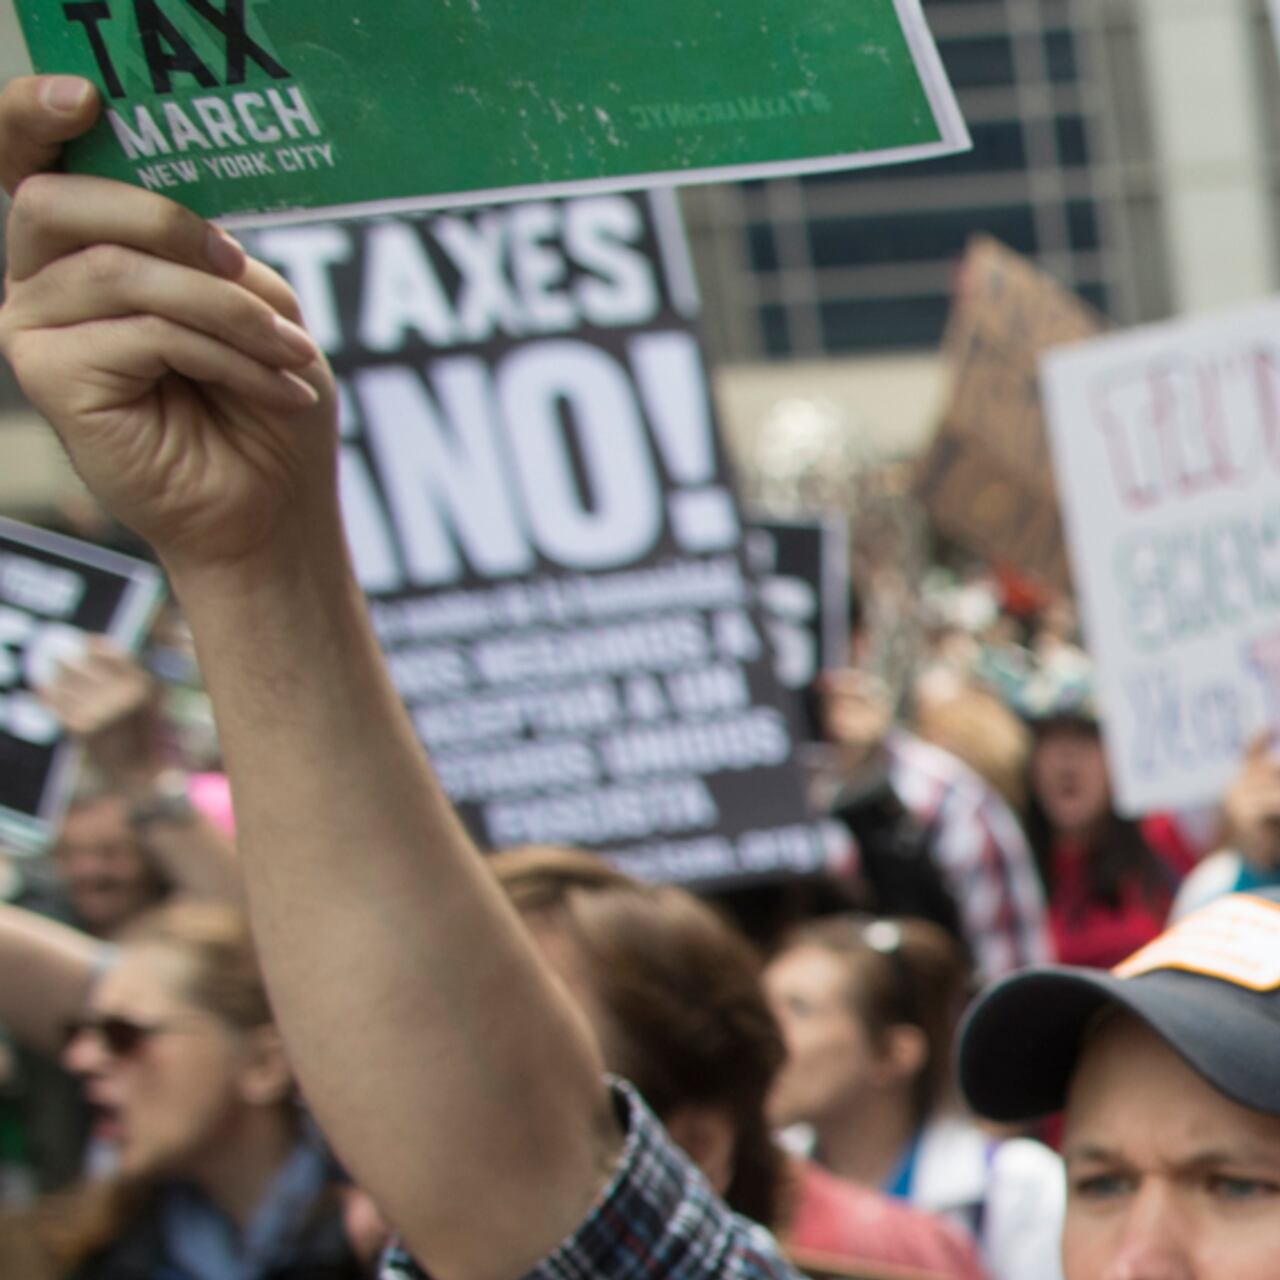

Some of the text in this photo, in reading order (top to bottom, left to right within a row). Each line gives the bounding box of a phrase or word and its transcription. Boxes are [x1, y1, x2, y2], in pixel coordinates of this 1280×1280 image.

[63, 0, 293, 98] TAX
[105, 86, 321, 160] MARCH
[136, 144, 335, 189] NEW YORK CITY
[258, 194, 662, 353] TAXES
